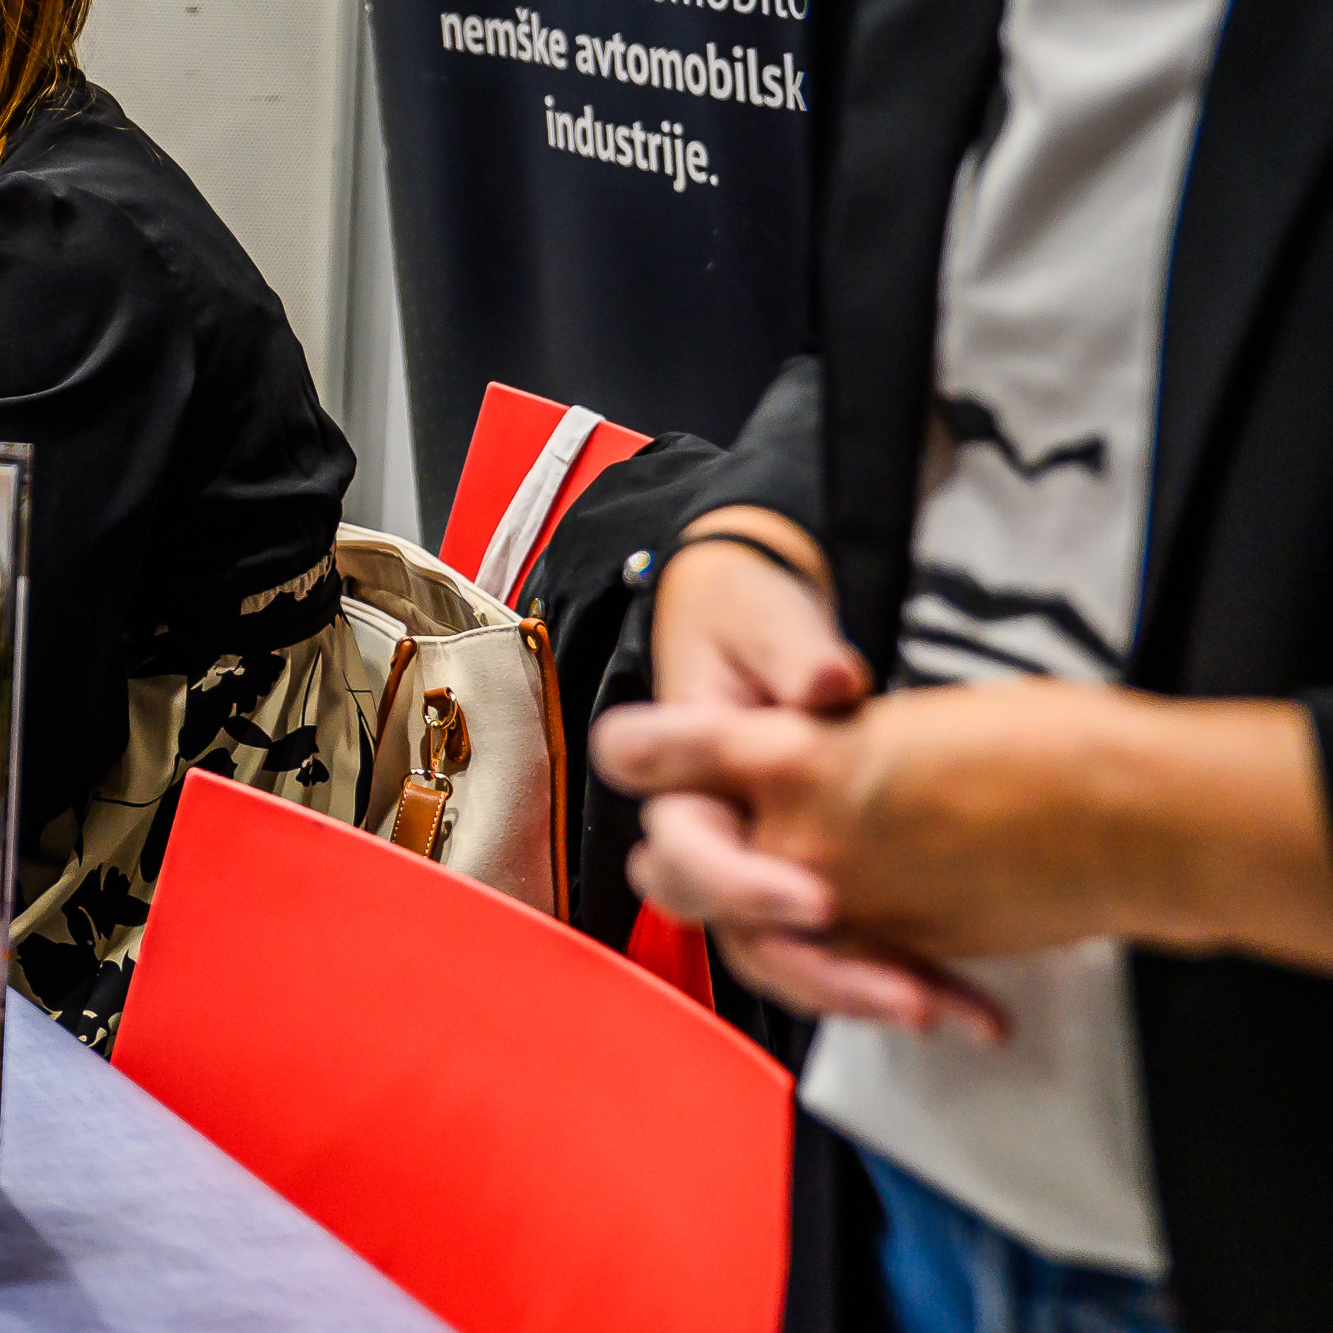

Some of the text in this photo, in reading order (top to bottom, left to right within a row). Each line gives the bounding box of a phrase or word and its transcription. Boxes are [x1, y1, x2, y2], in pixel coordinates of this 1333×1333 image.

[440, 7, 808, 112] nemške avtomobilsk
[543, 96, 719, 192] industrije.
